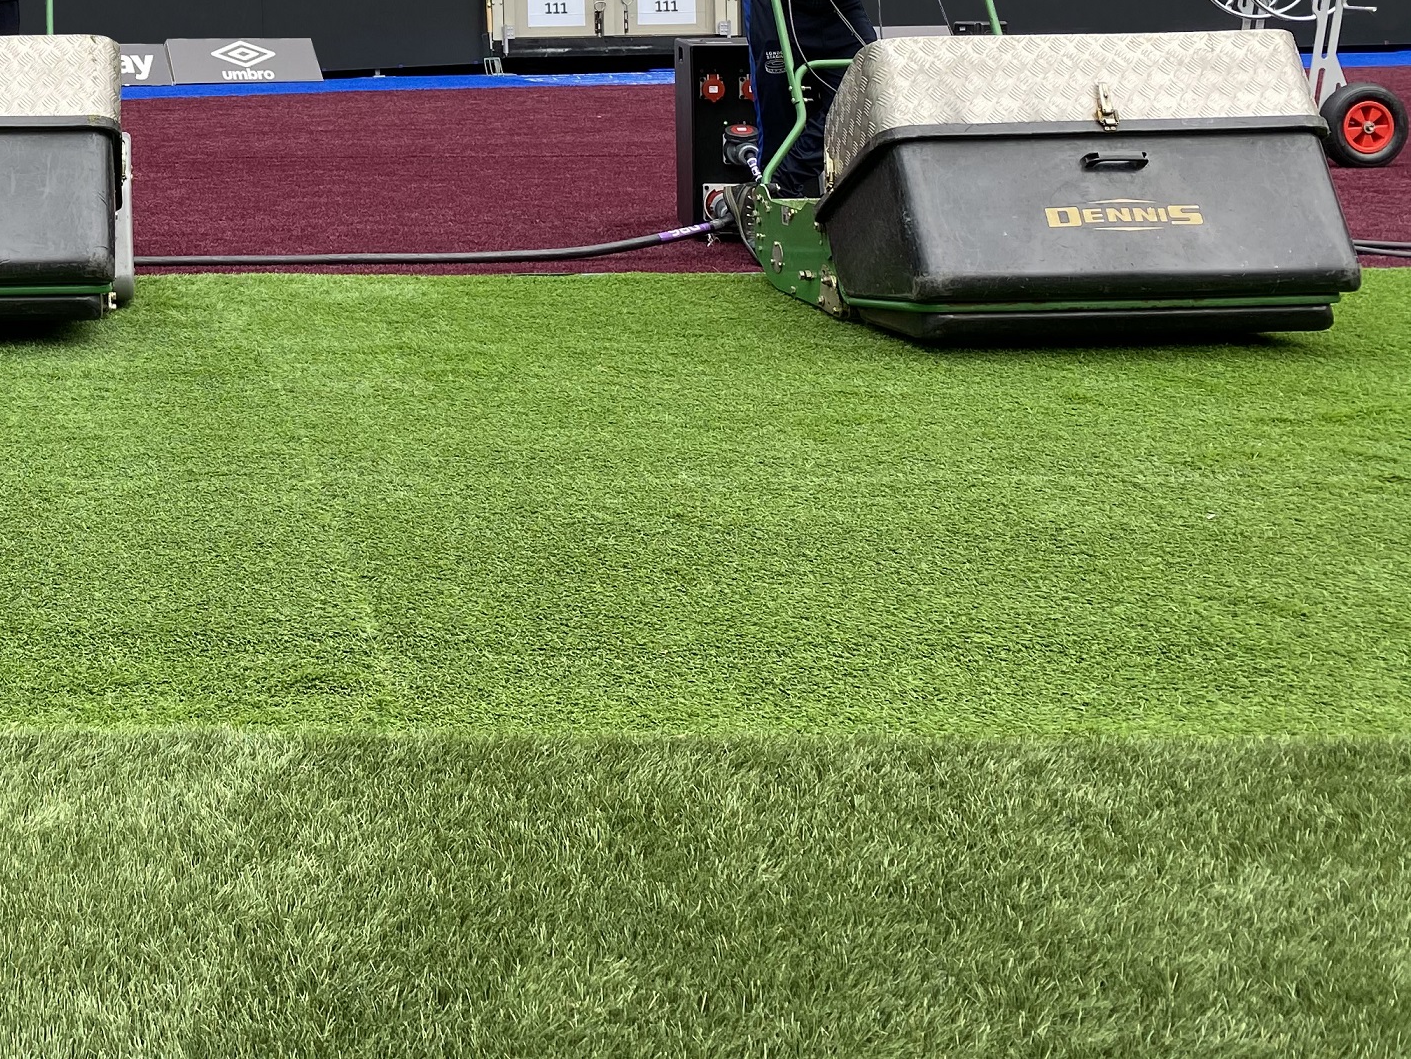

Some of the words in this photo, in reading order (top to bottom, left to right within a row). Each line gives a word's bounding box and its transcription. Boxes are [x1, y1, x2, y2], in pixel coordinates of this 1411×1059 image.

[545, 2, 568, 14] 111
[654, 0, 679, 12] 111
[221, 67, 275, 81] umbro
[1044, 204, 1204, 228] DENNIS
